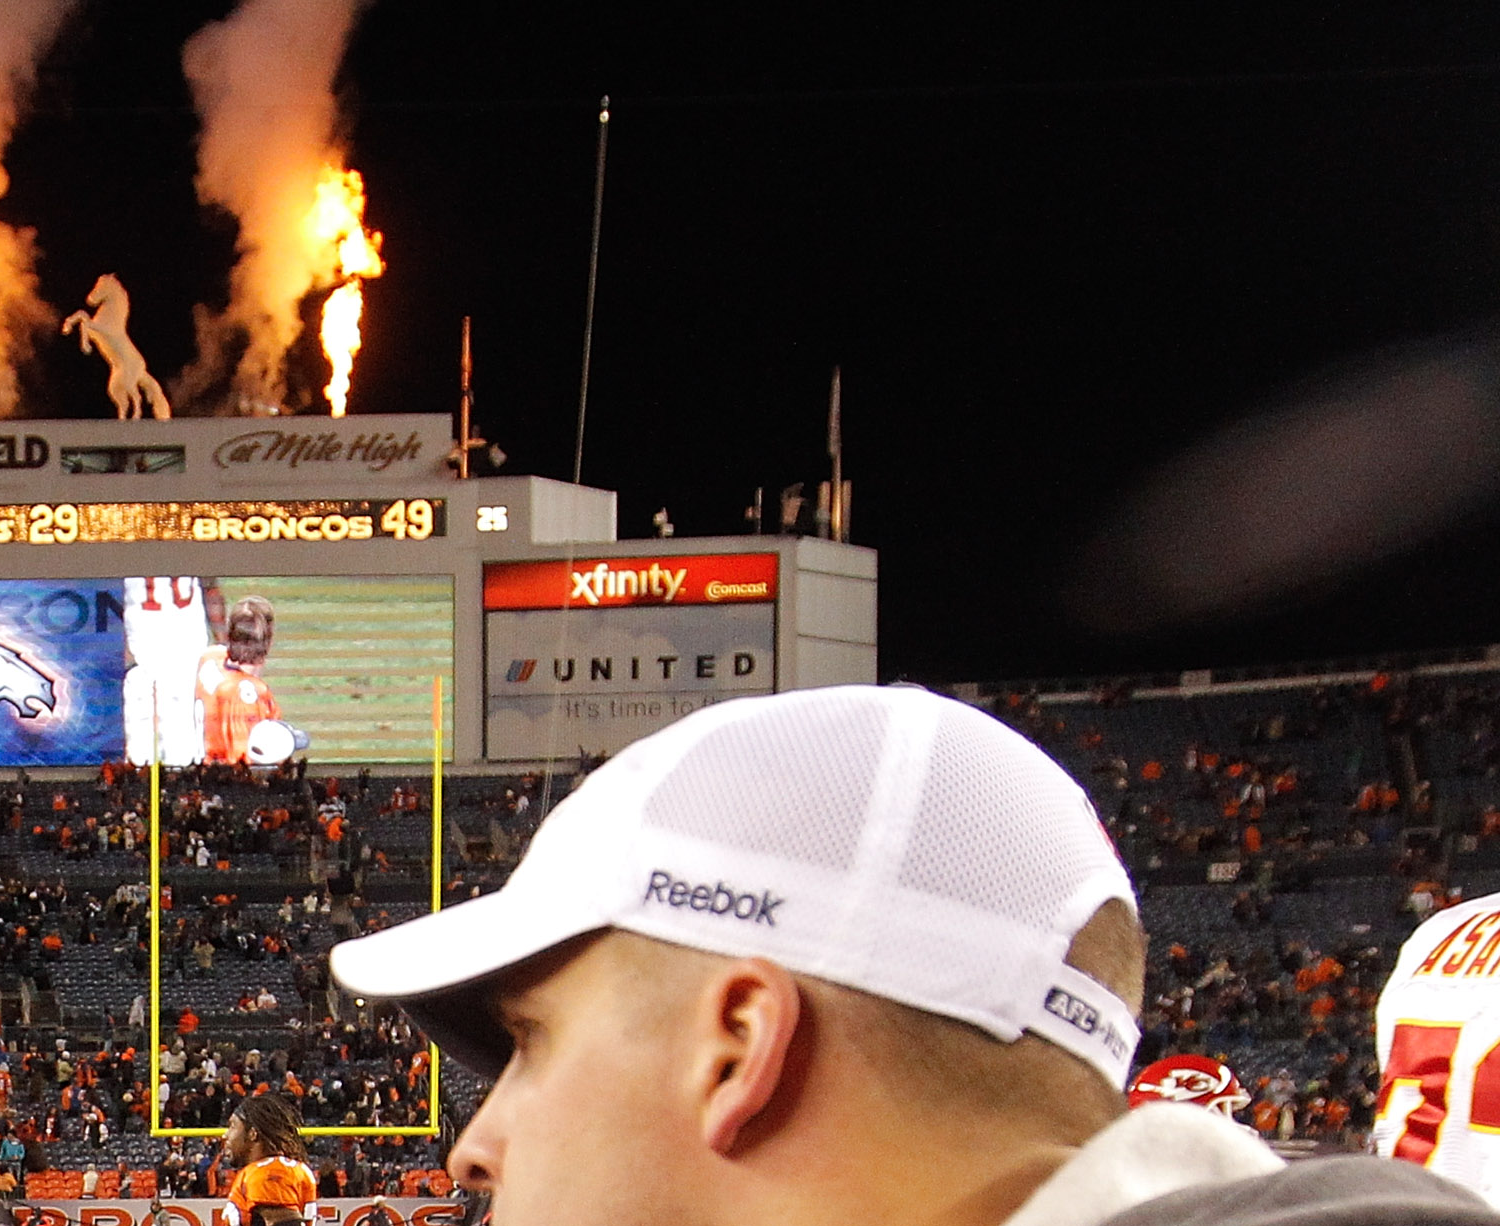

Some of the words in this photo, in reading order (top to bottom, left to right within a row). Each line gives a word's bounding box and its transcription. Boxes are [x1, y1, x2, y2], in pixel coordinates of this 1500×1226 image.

[260, 431, 345, 468] Mile
[348, 431, 422, 471] High
[29, 503, 78, 544] 29
[193, 514, 373, 541] BRONCOS
[381, 499, 433, 541] 49
[571, 563, 687, 605] xfinity
[554, 652, 756, 682] UNITED
[610, 698, 661, 718] time
[671, 696, 694, 716] to
[644, 869, 785, 928] Reebok
[1412, 911, 1500, 977] ASA
